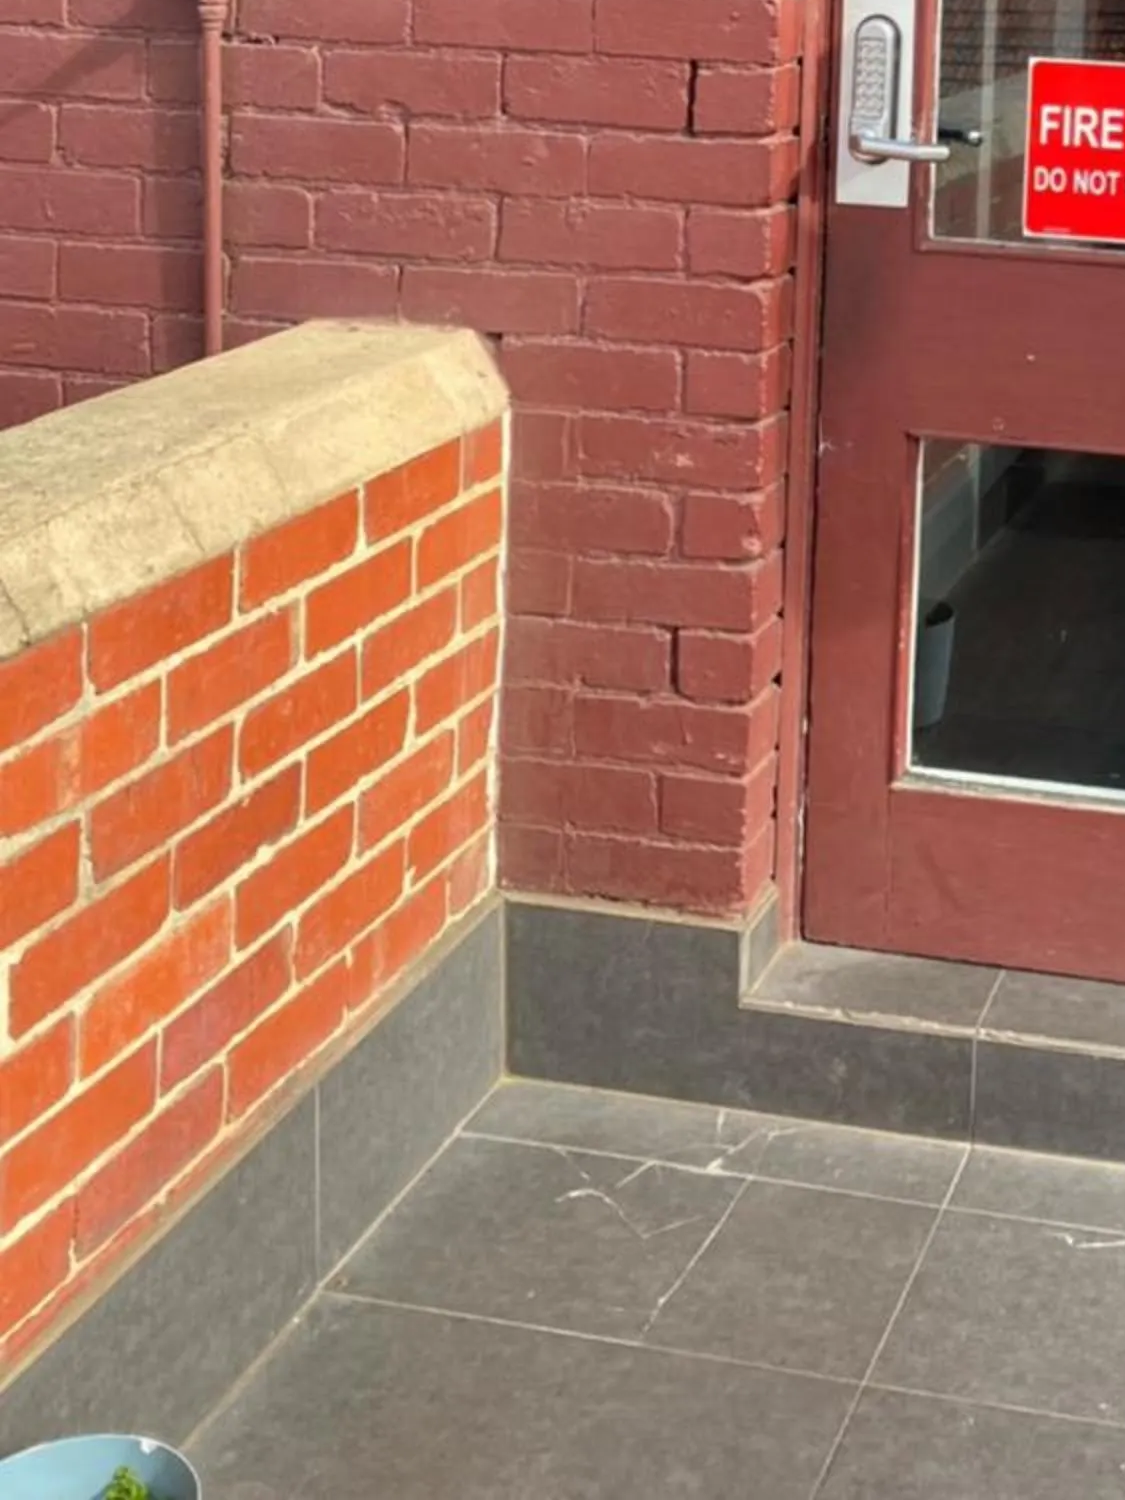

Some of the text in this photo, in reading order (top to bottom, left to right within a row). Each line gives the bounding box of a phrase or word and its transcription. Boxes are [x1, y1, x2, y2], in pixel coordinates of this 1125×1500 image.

[1039, 104, 1125, 150] FIRE
[1033, 165, 1067, 193] DO
[1073, 169, 1120, 196] NOT
